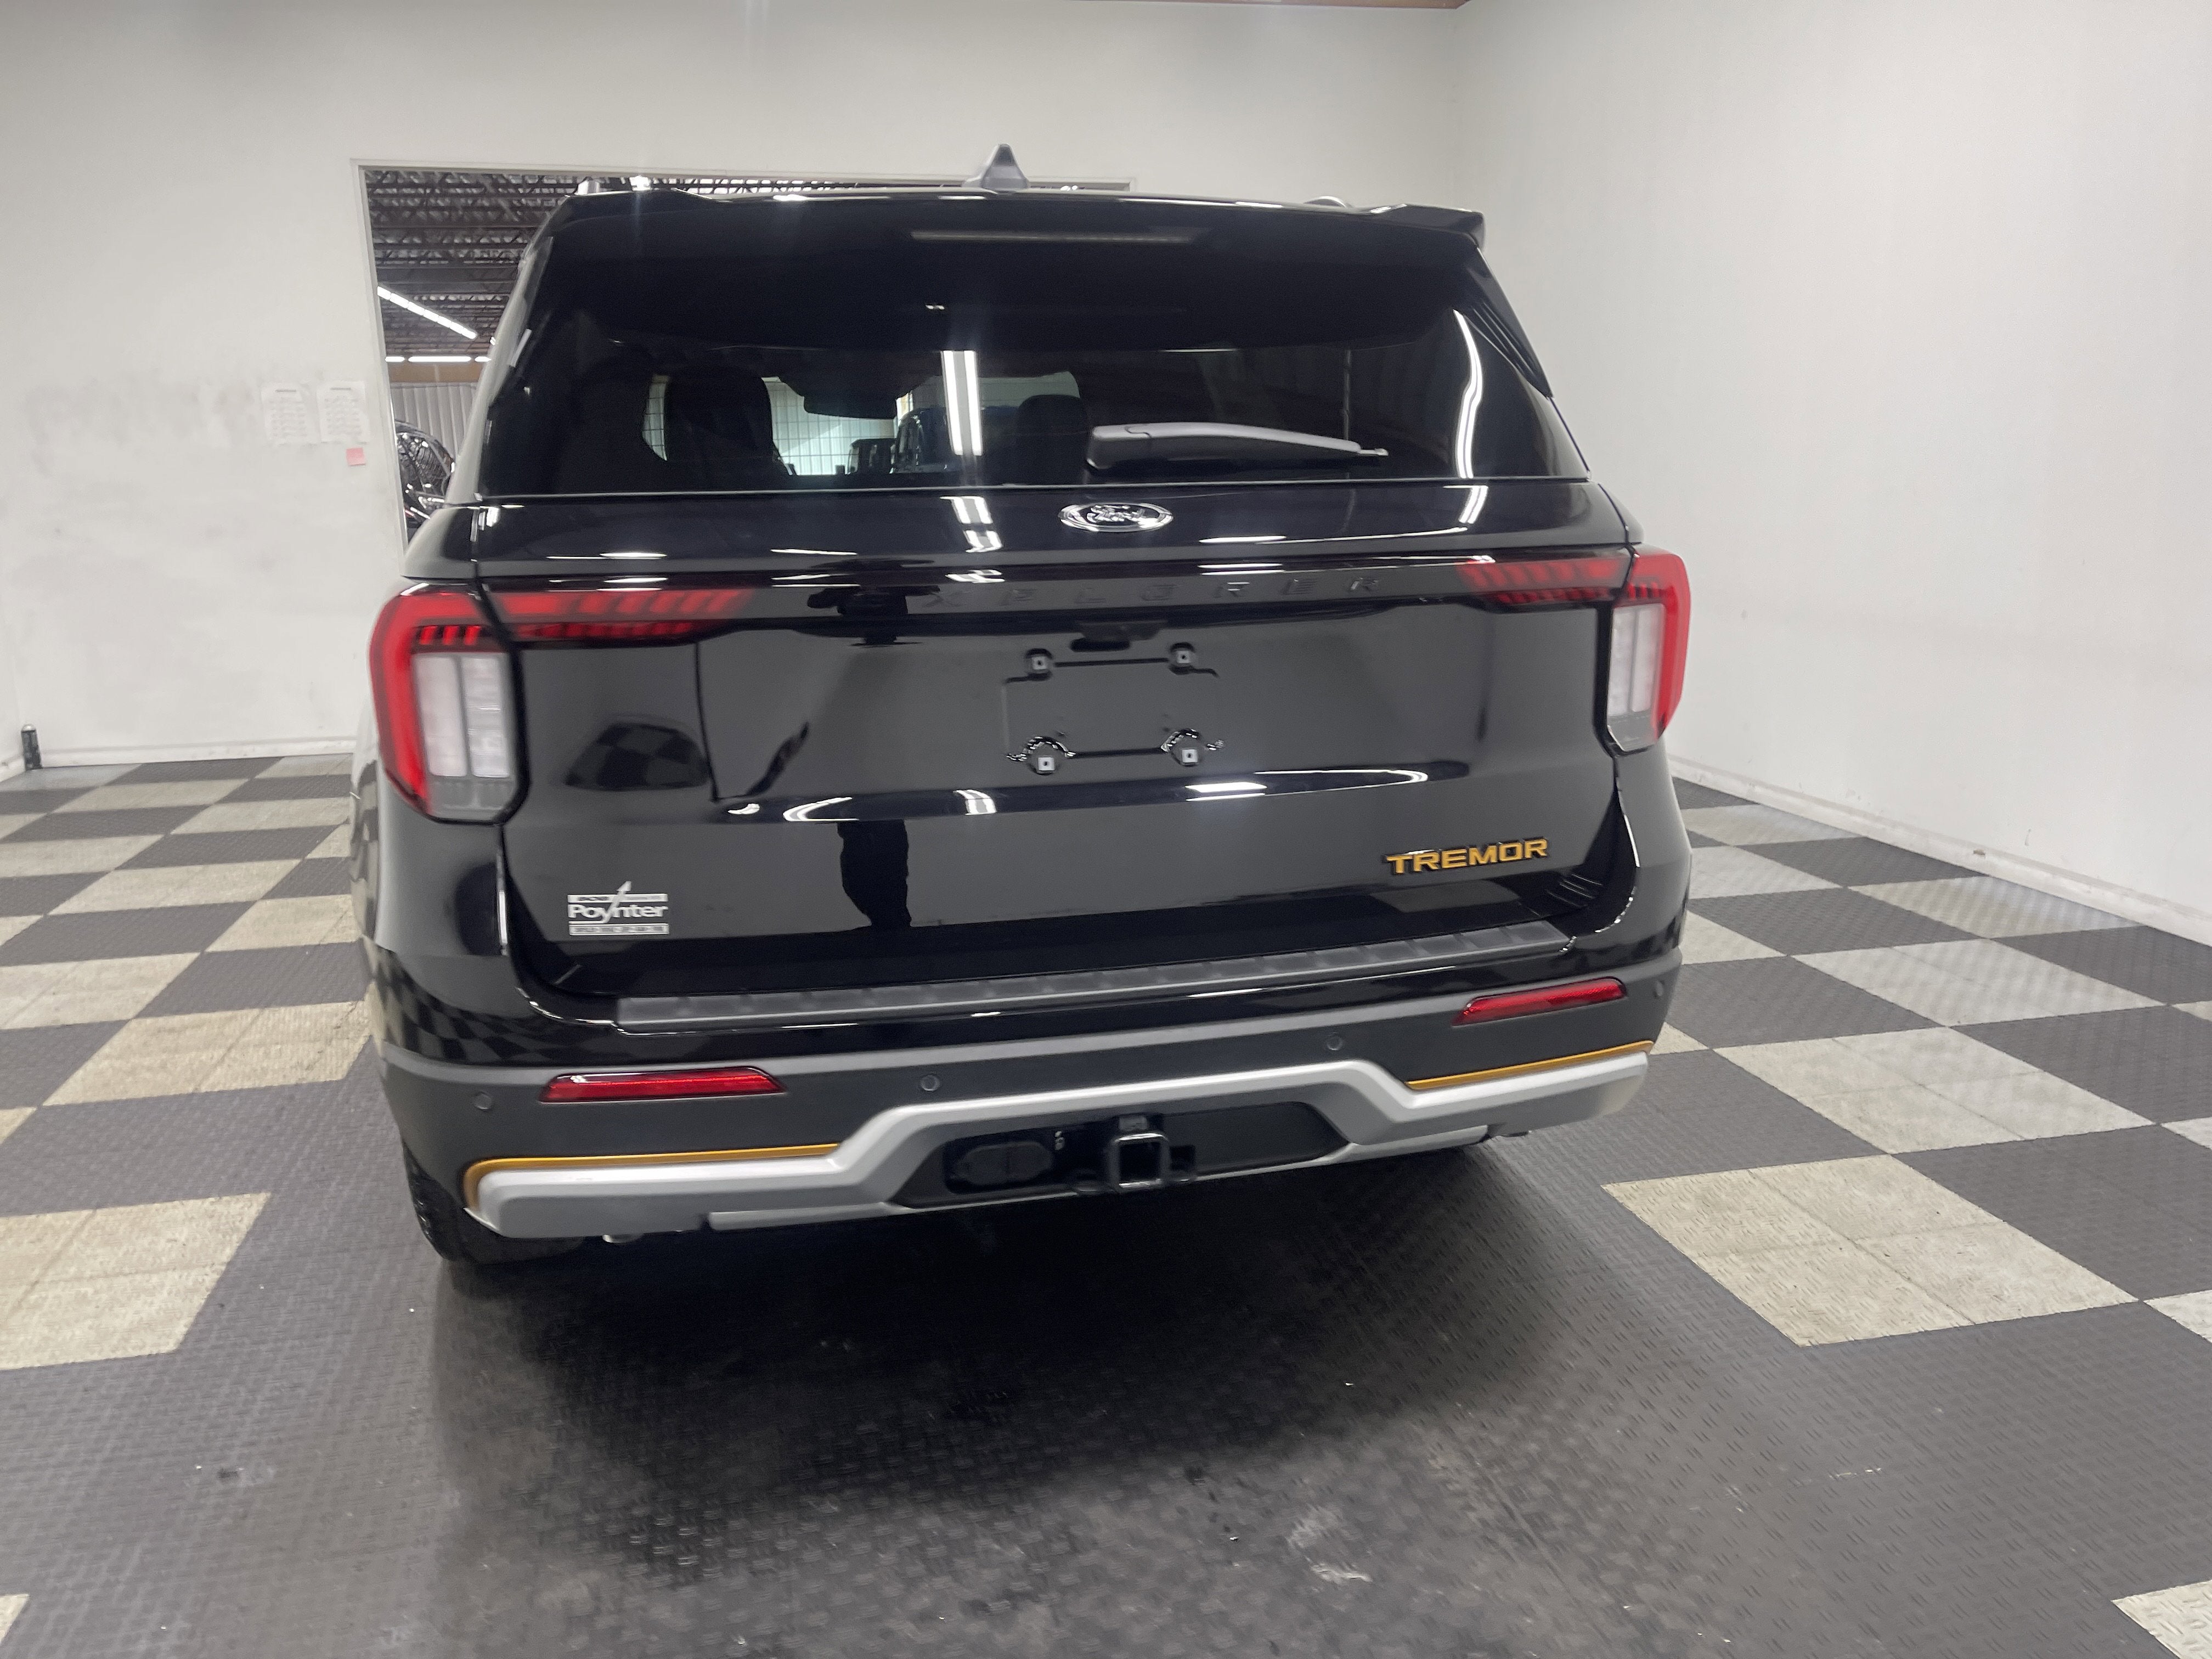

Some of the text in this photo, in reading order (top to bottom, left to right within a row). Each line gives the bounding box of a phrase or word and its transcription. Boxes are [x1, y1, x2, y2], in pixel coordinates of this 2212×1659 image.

[846, 577, 1383, 608] XPLORER
[1386, 838, 1548, 874] TREMOR
[567, 903, 669, 923] Poynter
